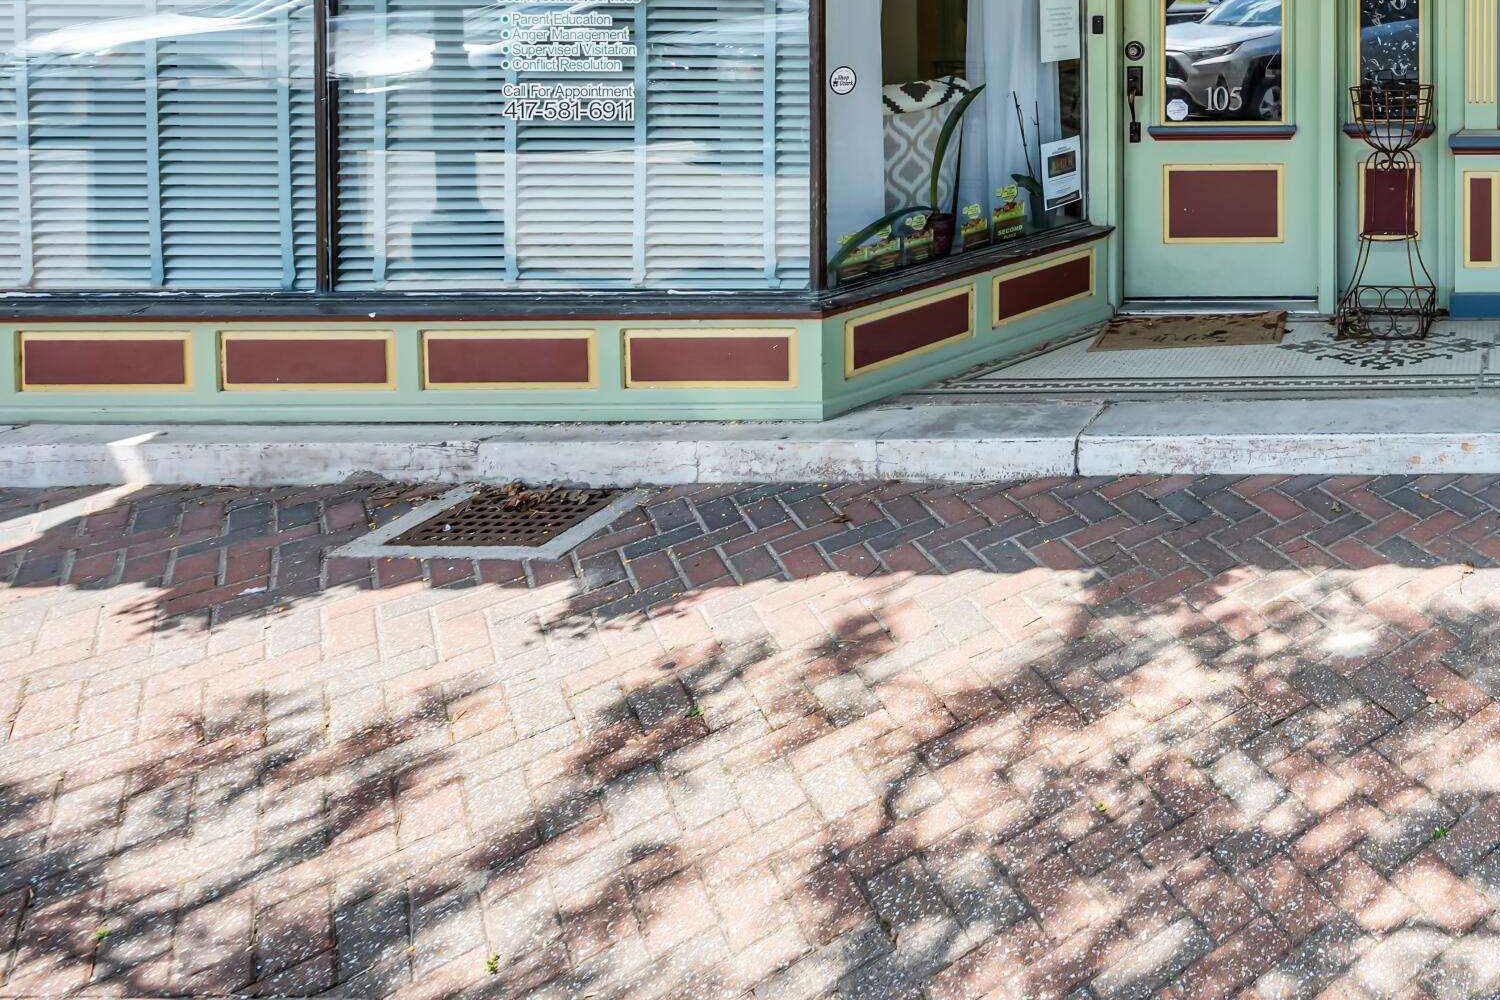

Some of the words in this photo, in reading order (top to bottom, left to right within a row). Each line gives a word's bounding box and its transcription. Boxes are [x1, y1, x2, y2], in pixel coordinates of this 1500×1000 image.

[512, 13, 550, 25] Parent
[553, 12, 612, 25] Education
[512, 28, 549, 43] Anger
[551, 28, 629, 43] Management
[512, 43, 580, 57] Supervised
[582, 43, 637, 56] Visitation
[512, 57, 557, 71] Conflict
[559, 57, 622, 71] Resolution
[503, 84, 527, 98] Call
[530, 84, 552, 98] For
[554, 84, 634, 101] Appointment
[1205, 86, 1243, 111] 105
[503, 101, 634, 120] 417-581-6911
[997, 224, 1023, 236] SECOND
